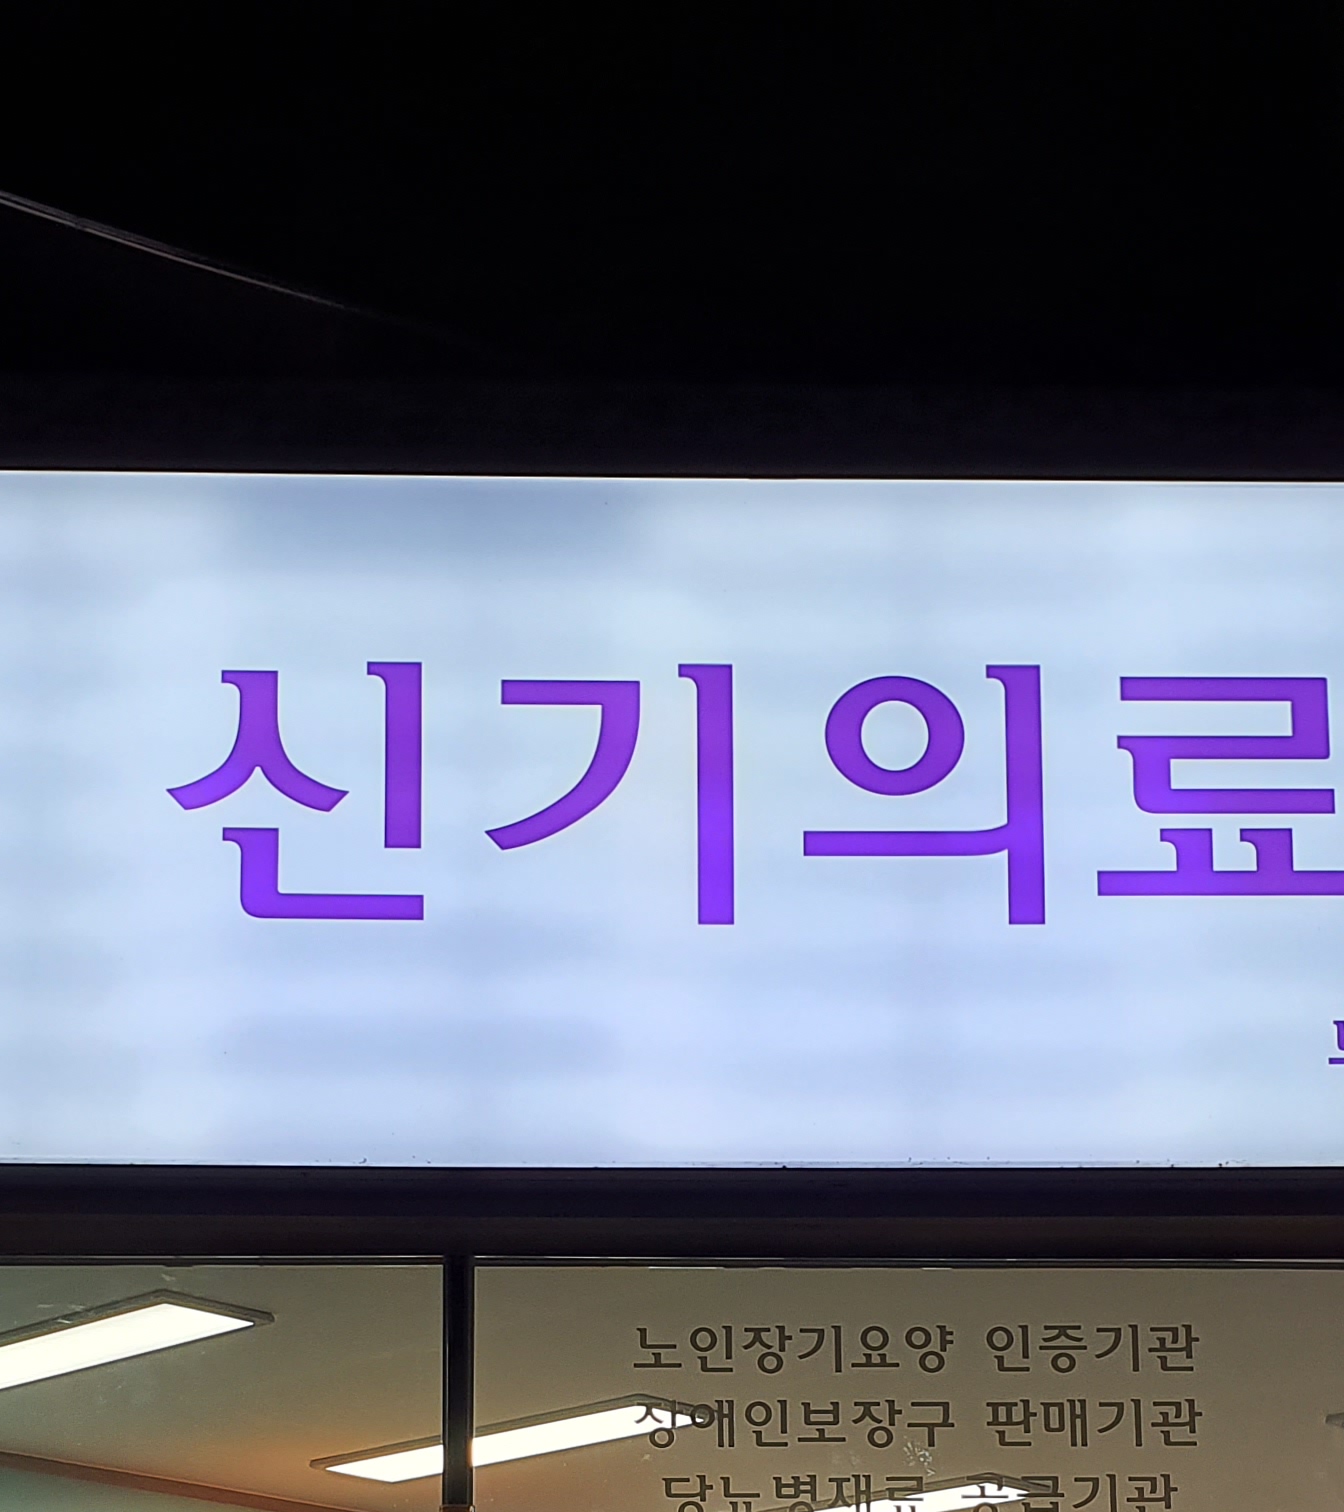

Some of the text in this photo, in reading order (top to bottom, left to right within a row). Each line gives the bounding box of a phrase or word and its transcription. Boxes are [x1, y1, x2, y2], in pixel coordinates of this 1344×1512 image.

[633, 1323, 1201, 1375] 노인장기요양 인증기관
[633, 1398, 1203, 1450] 장애인보장구 판매기관
